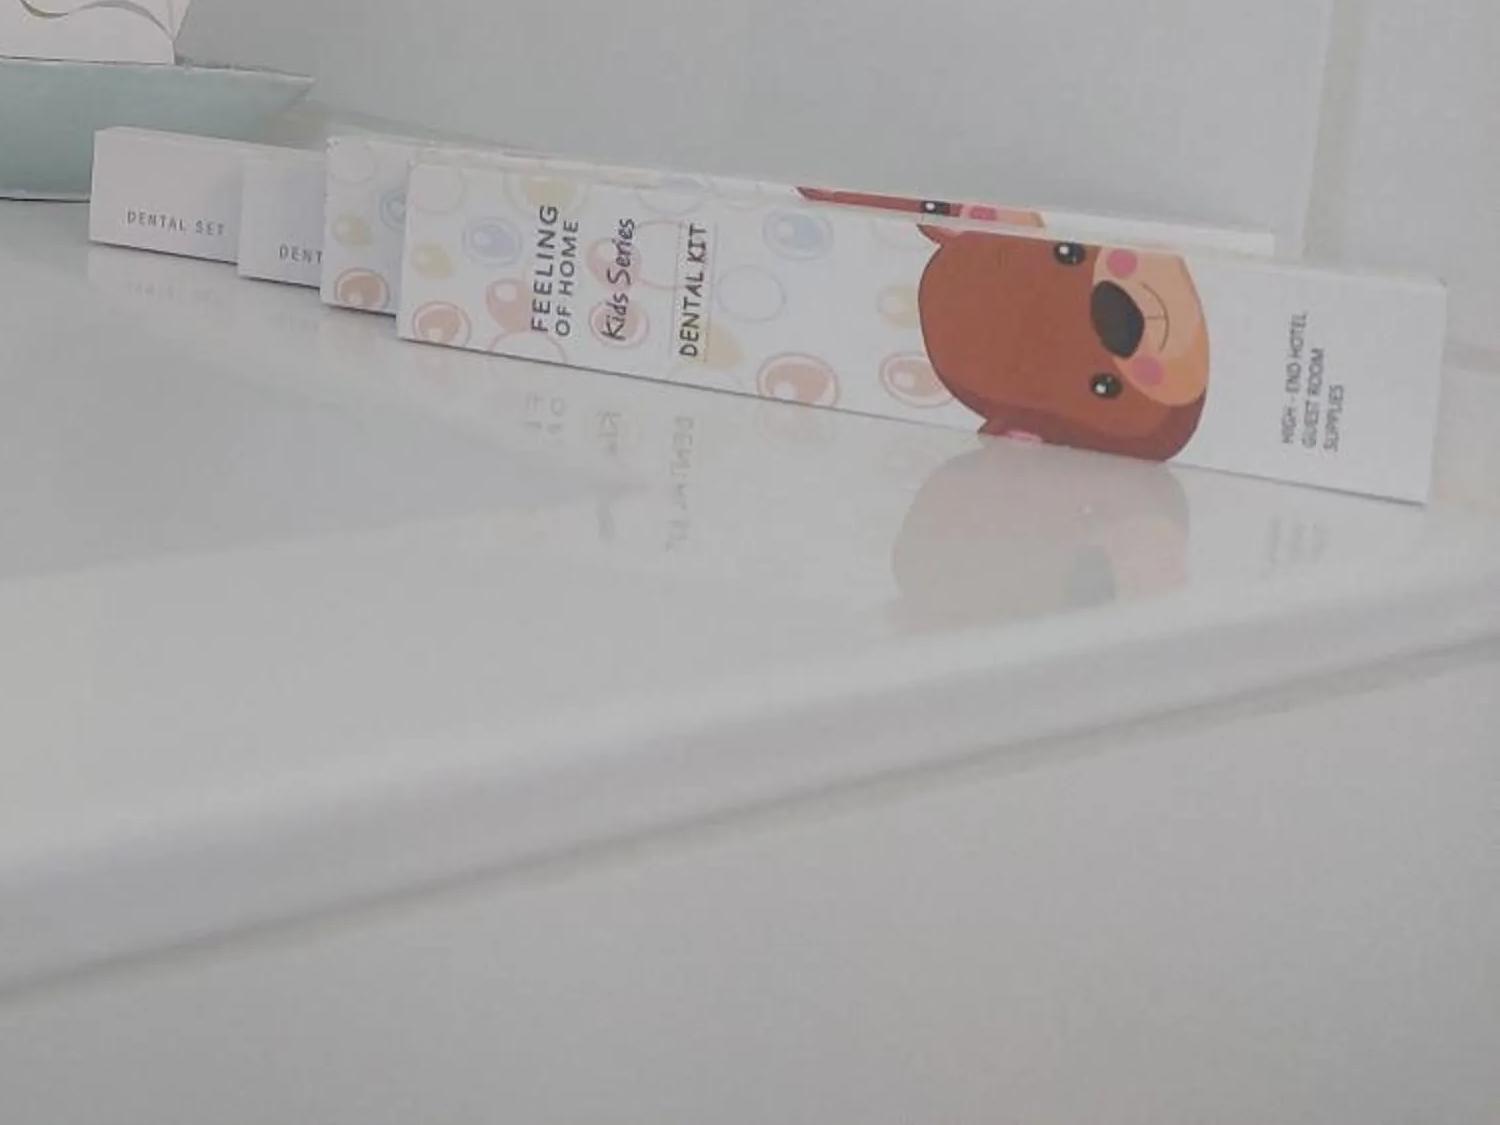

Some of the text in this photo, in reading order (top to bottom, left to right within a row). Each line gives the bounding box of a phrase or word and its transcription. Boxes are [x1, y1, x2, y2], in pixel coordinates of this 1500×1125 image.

[126, 210, 225, 236] DENTAL SET
[278, 244, 323, 265] DENT
[531, 204, 558, 333] FEELING
[555, 219, 579, 337] OF HOME
[600, 218, 634, 341] Kids Series
[679, 222, 708, 357] DENTAL KIT
[1288, 312, 1307, 358] HOTEL
[1285, 362, 1301, 393] END
[1301, 348, 1324, 448] GUEST ROOM
[1281, 407, 1296, 444] HIGH
[1322, 384, 1344, 452] SUPPLIES
